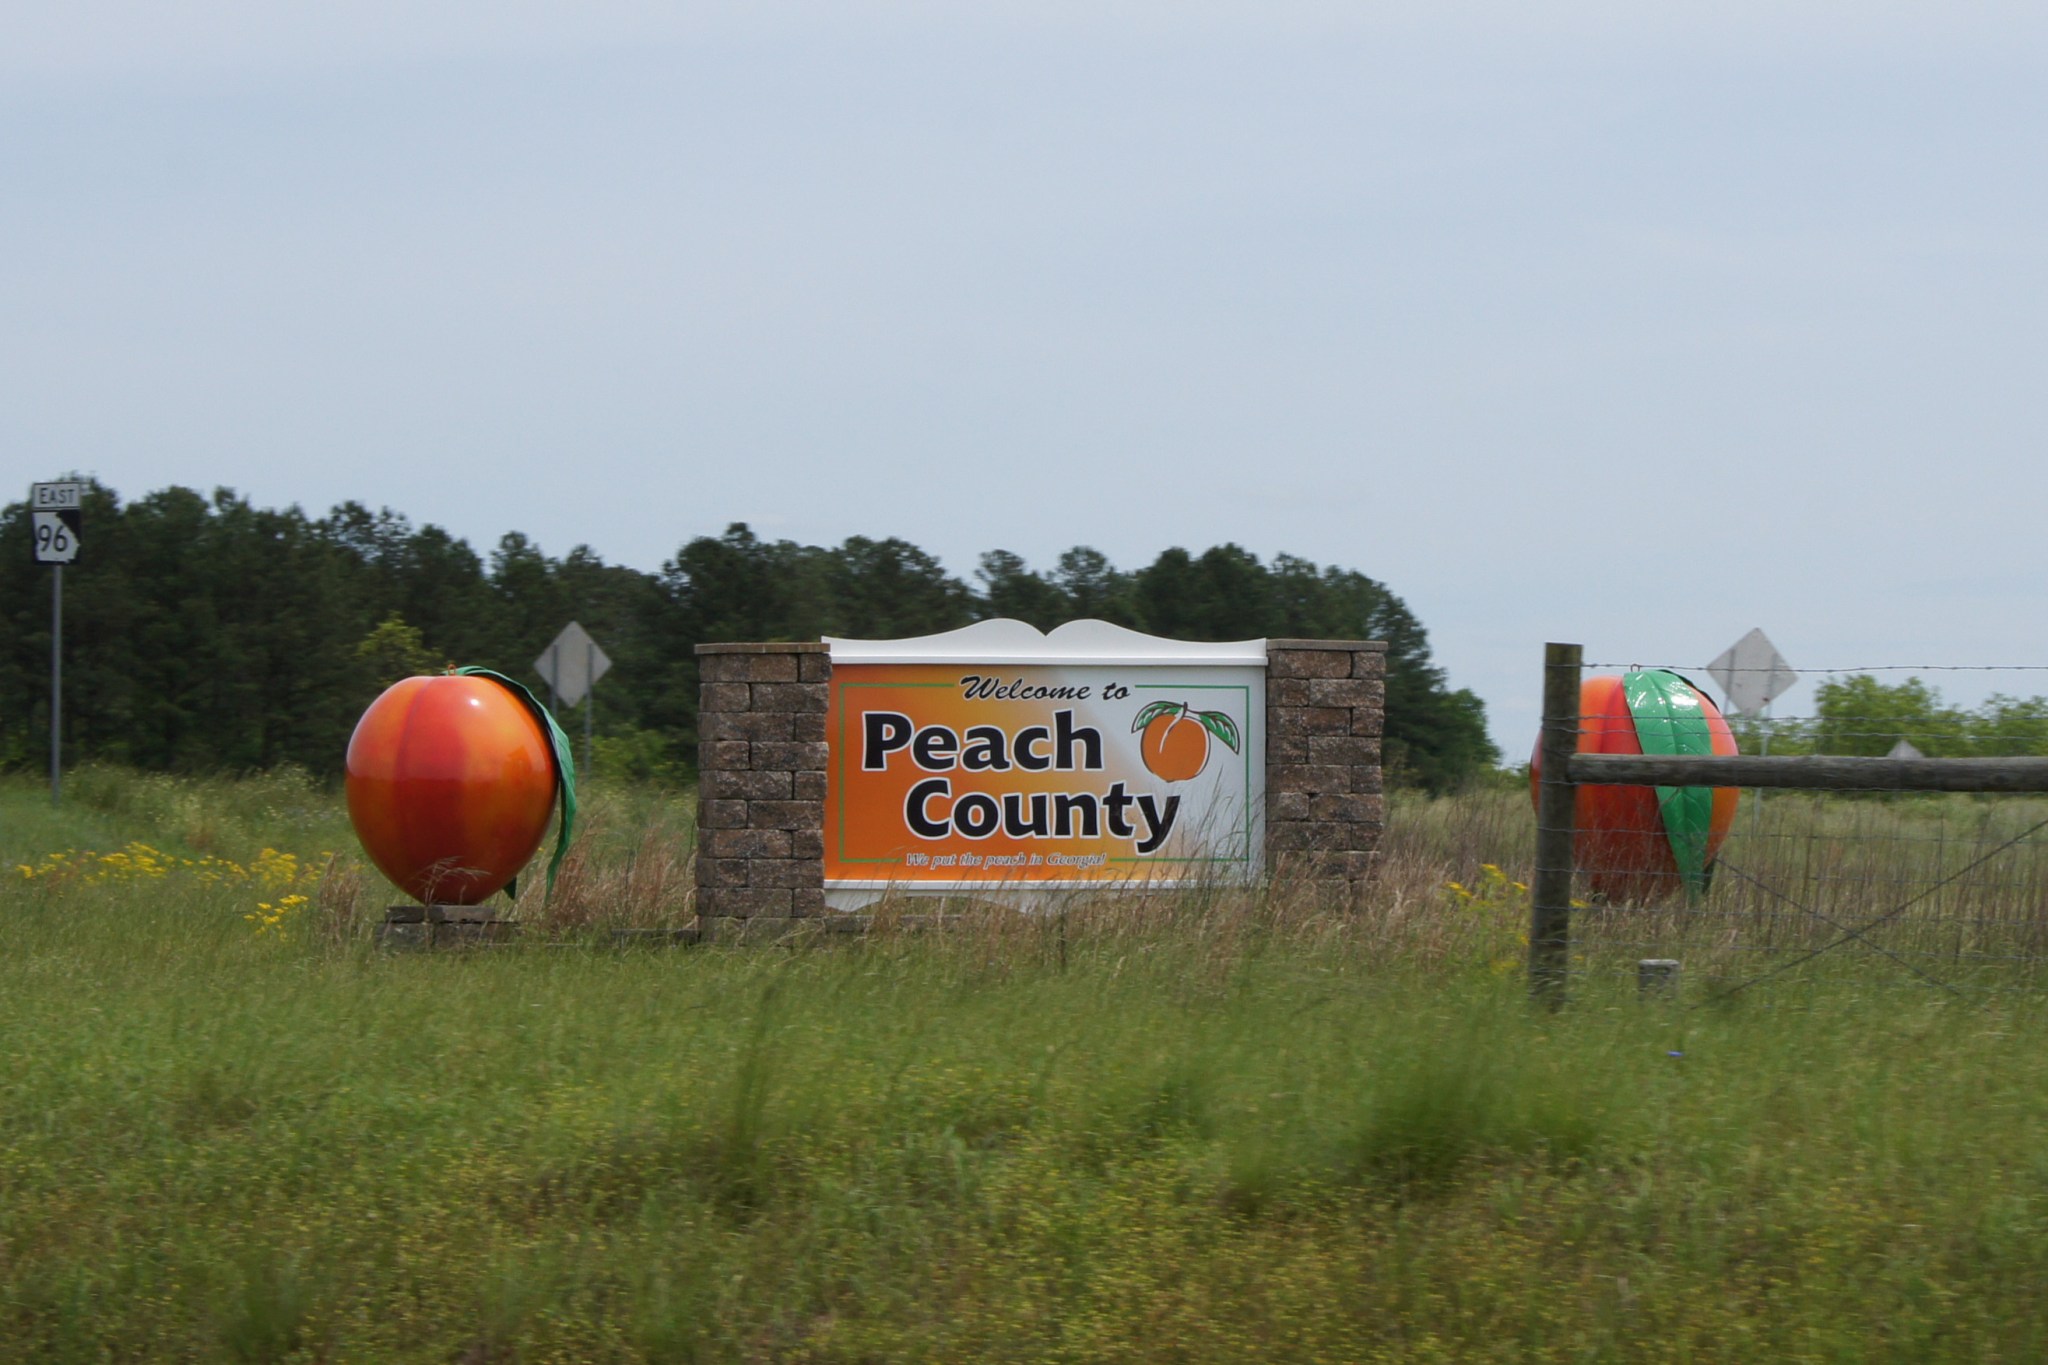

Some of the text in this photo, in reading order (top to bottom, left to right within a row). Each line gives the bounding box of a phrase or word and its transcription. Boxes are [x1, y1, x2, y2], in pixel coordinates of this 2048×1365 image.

[40, 487, 75, 504] EAST
[39, 524, 68, 552] 96
[960, 675, 1130, 701] Welcome to
[863, 711, 1103, 771] Peach
[904, 778, 1181, 853] County
[906, 852, 1106, 870] We put the peach in Georgia!
